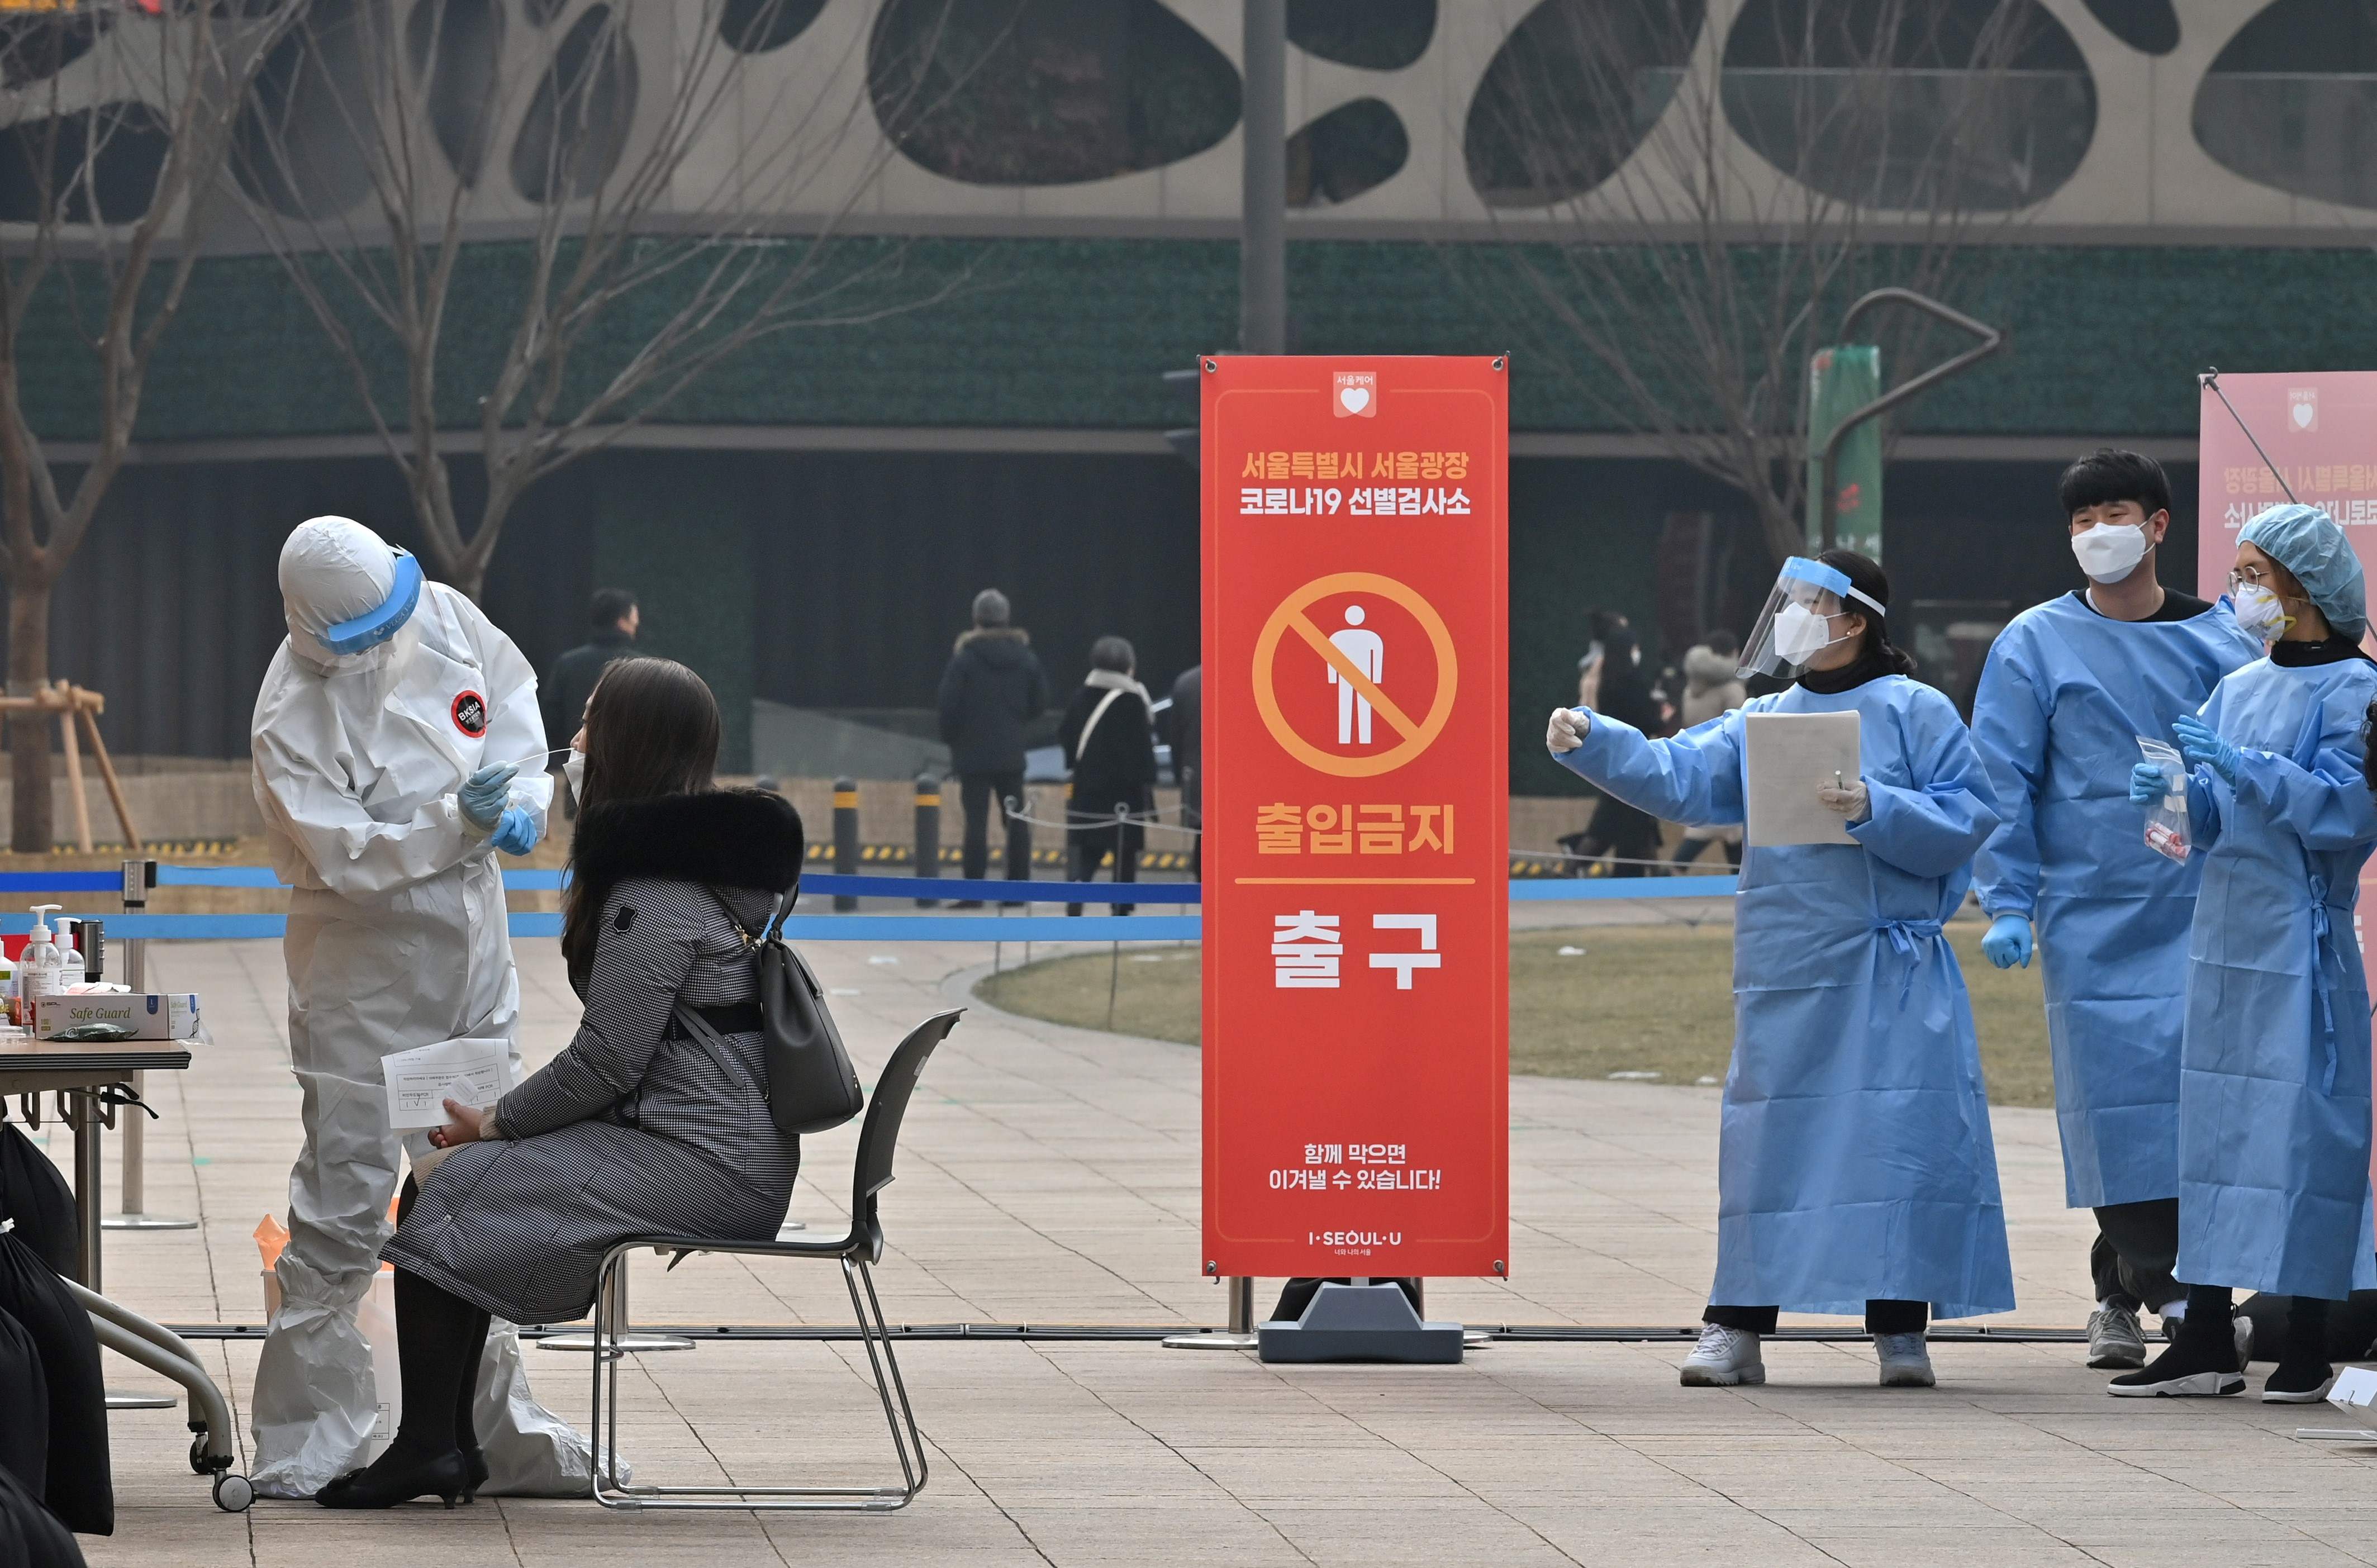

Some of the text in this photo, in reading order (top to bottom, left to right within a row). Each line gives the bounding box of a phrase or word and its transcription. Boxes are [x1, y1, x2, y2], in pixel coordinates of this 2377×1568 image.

[1337, 376, 1373, 386] 서울케어
[1242, 452, 1469, 479] 서울특별시 서울광장
[1240, 487, 1471, 515] 코로나19 선별검사소
[458, 701, 481, 721] BKSIA
[1256, 802, 1453, 854] 출입금지
[1271, 910, 1441, 990] 출 구
[69, 1006, 131, 1022] Safe Guard
[1304, 1143, 1405, 1165] 함께 막으면
[1270, 1169, 1441, 1190] 이겨낼 수 있습니다!
[1334, 1247, 1347, 1256] 너와
